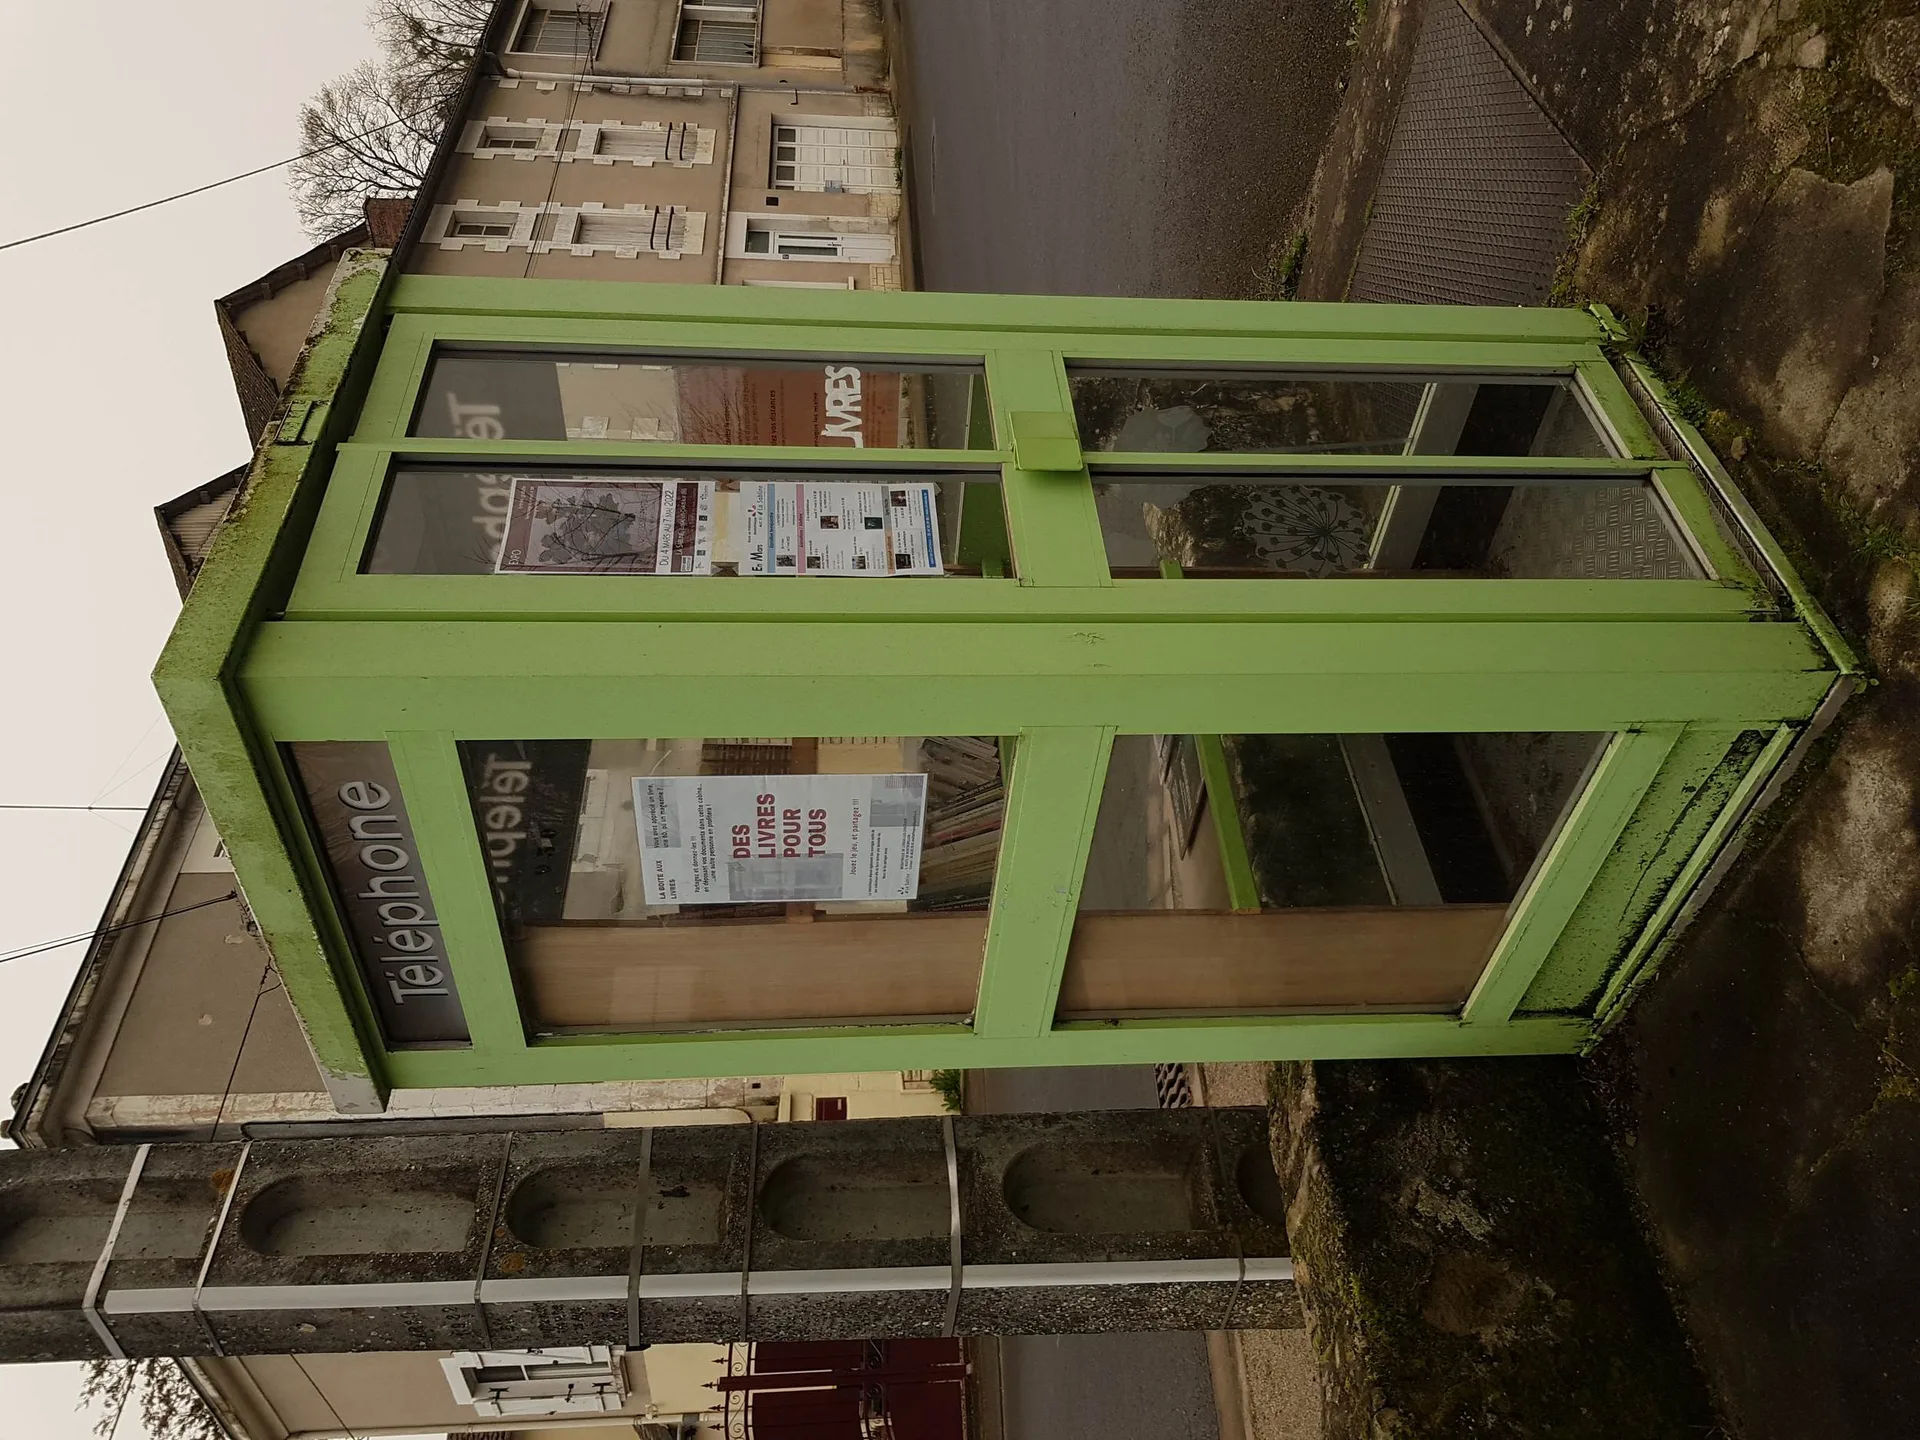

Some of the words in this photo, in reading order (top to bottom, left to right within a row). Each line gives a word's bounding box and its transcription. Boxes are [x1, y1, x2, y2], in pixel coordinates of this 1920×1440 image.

[664, 490, 674, 506] 2022
[663, 524, 671, 532] AU
[663, 533, 671, 548] MARS
[659, 556, 669, 566] DU
[750, 544, 763, 561] Mars
[752, 564, 763, 572] En
[706, 807, 714, 828] profitera
[756, 793, 776, 858] LIVRES
[851, 807, 861, 832] partagez
[732, 824, 751, 859] DES
[782, 808, 802, 858] POUR
[808, 808, 827, 858] TOUS
[708, 836, 716, 856] personne
[850, 841, 858, 852] jeu,
[702, 865, 710, 886] déposant
[849, 860, 857, 876] Jouez
[656, 874, 665, 891] BOITE
[669, 878, 677, 900] LIVRES
[693, 874, 701, 892] Partagez
[336, 780, 450, 1005] Téléphone
[658, 892, 666, 900] LA
